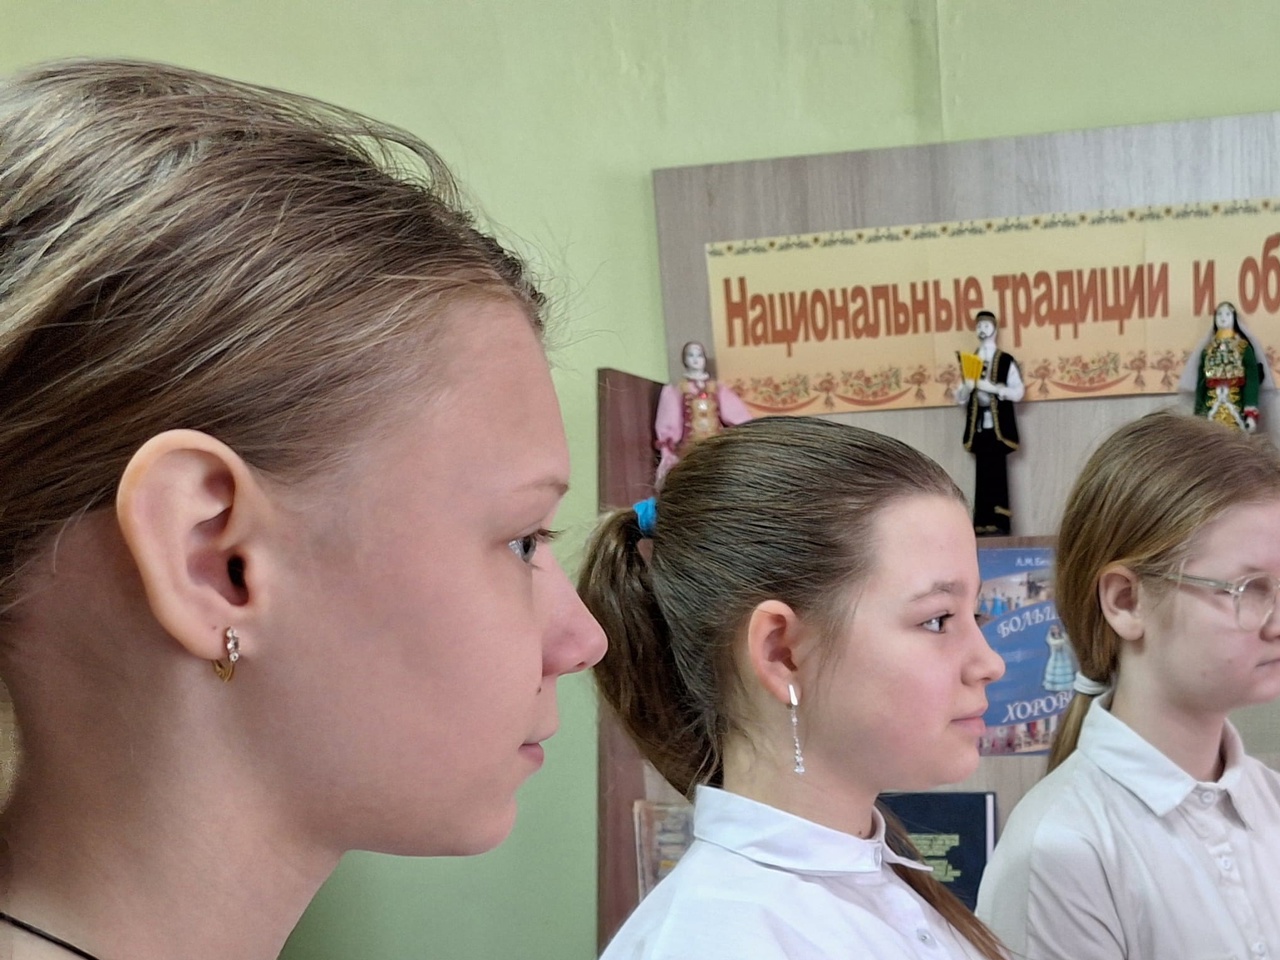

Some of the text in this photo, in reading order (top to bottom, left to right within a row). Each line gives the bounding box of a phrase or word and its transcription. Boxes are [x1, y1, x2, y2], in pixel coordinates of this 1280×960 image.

[723, 276, 984, 357] Национальные
[993, 262, 1169, 347] традиции
[1193, 259, 1215, 316] и
[997, 605, 1058, 639] БОЛЬШ
[1002, 690, 1075, 723] ХОРОВ
